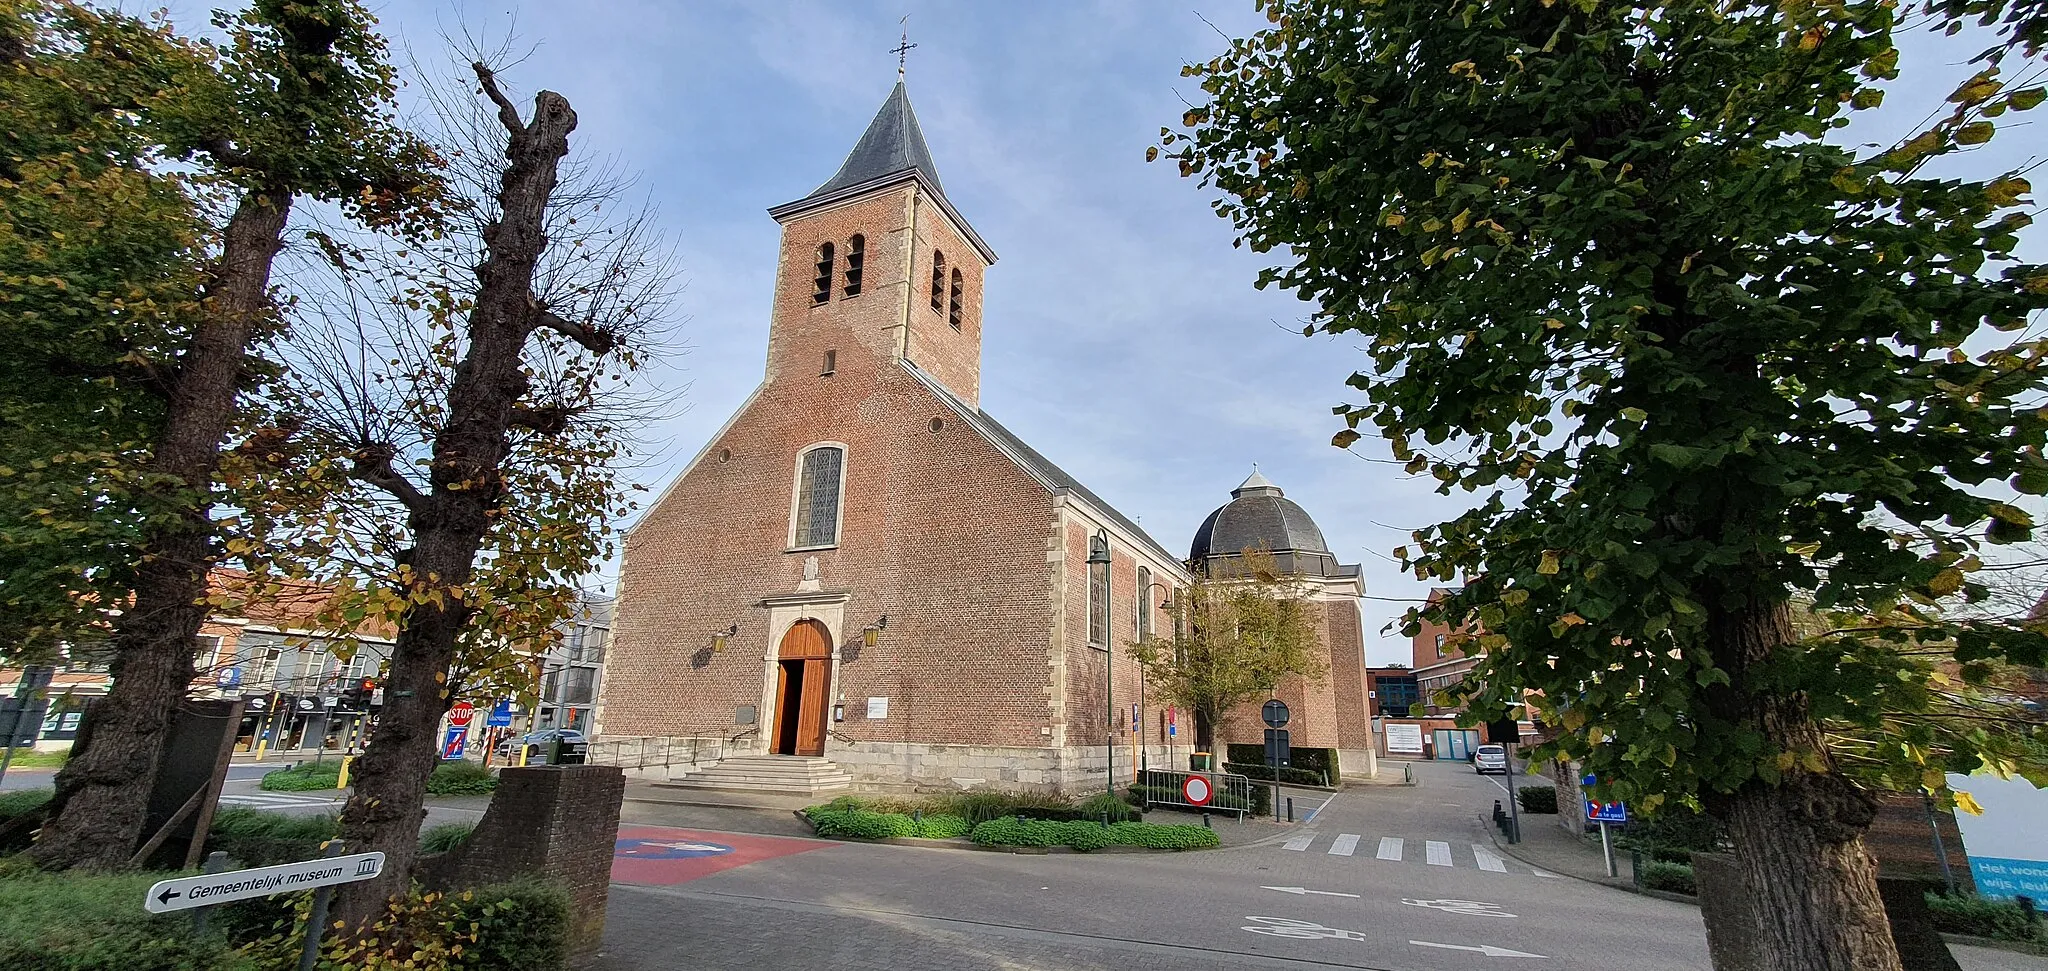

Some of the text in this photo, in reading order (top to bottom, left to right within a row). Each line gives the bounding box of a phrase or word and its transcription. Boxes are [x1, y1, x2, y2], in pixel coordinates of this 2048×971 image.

[451, 708, 473, 719] STOP
[1978, 863, 2007, 874] Het
[188, 865, 344, 900] Gemeentelijk museum
